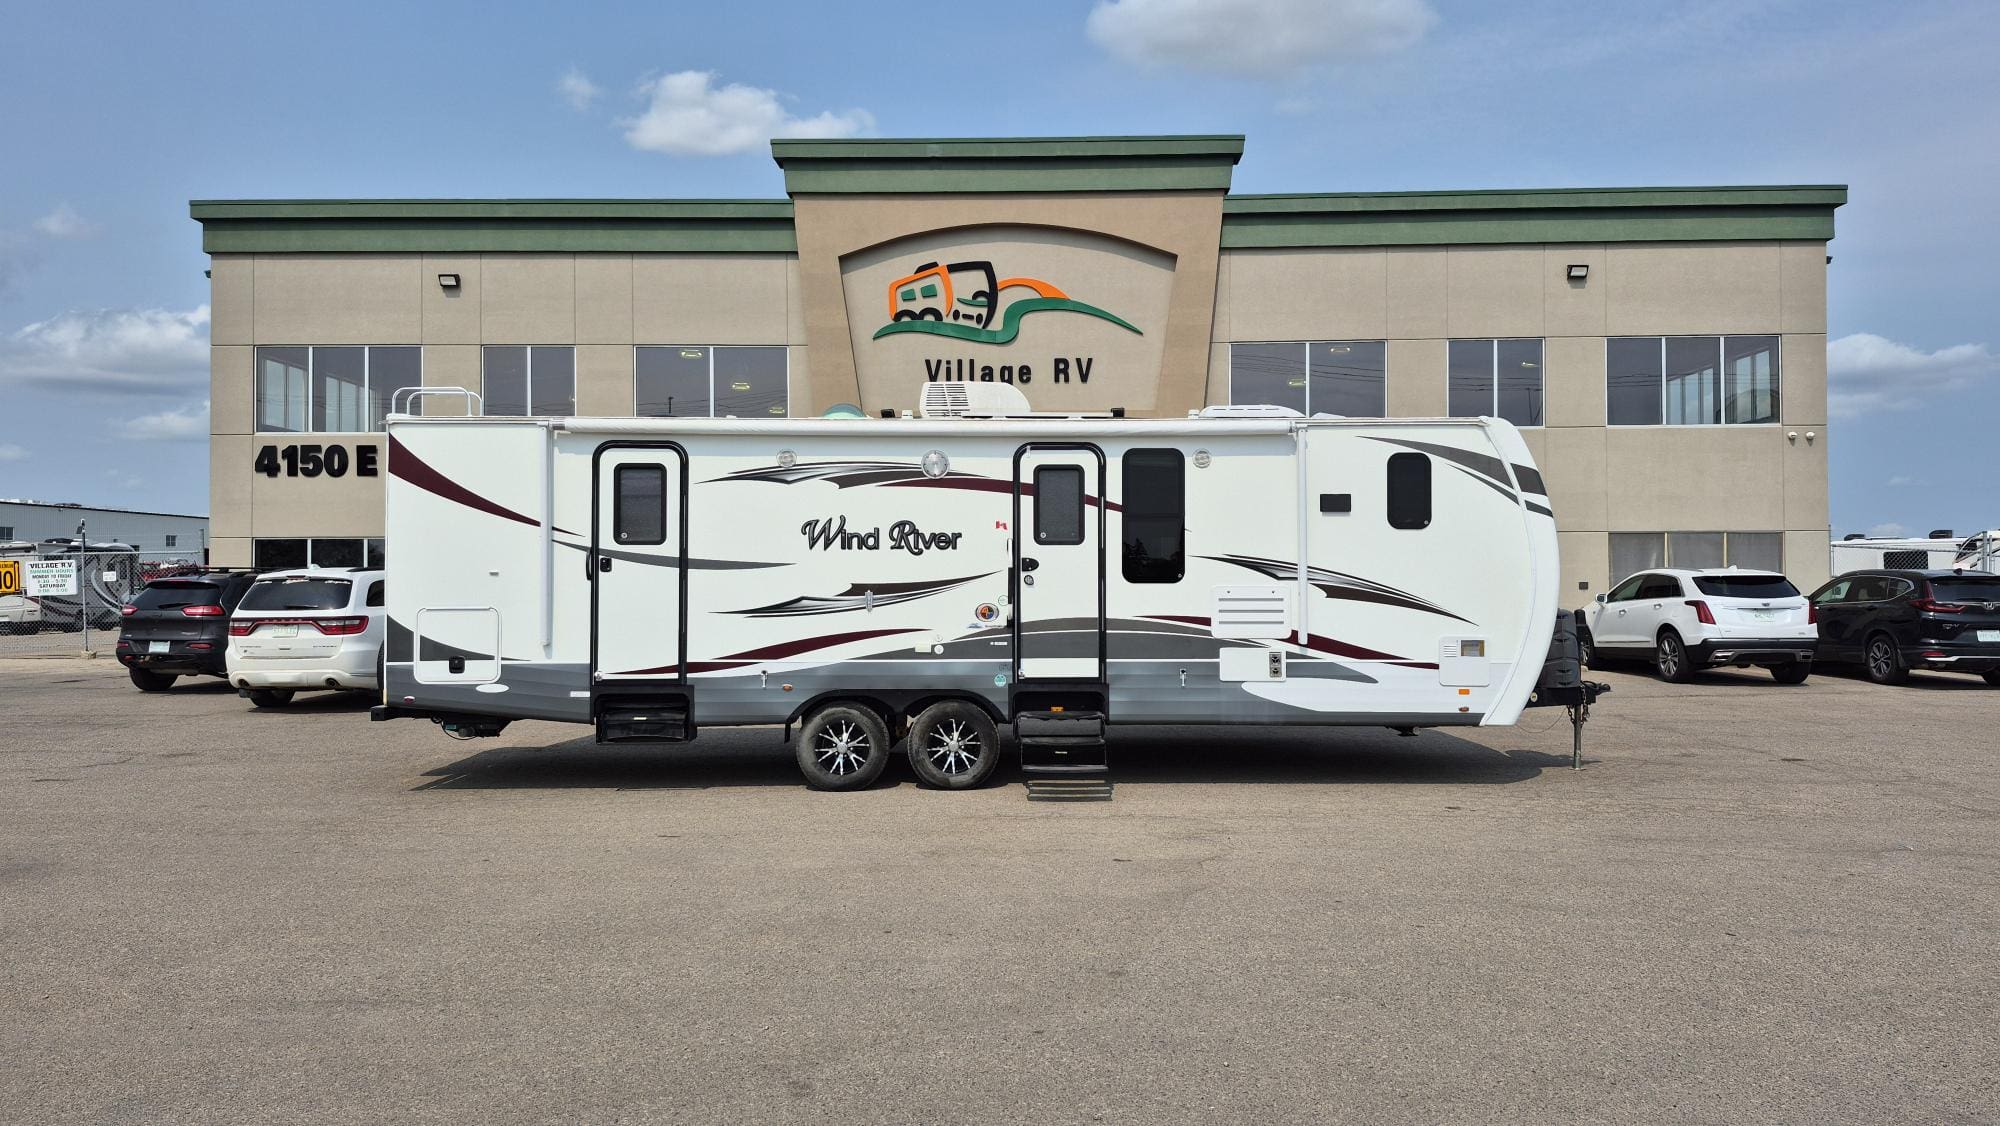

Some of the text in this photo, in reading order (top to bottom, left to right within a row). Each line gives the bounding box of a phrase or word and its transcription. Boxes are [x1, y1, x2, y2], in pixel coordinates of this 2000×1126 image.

[924, 357, 1093, 385] Village RV
[254, 444, 378, 478] 4150 E
[801, 514, 962, 556] Wind River
